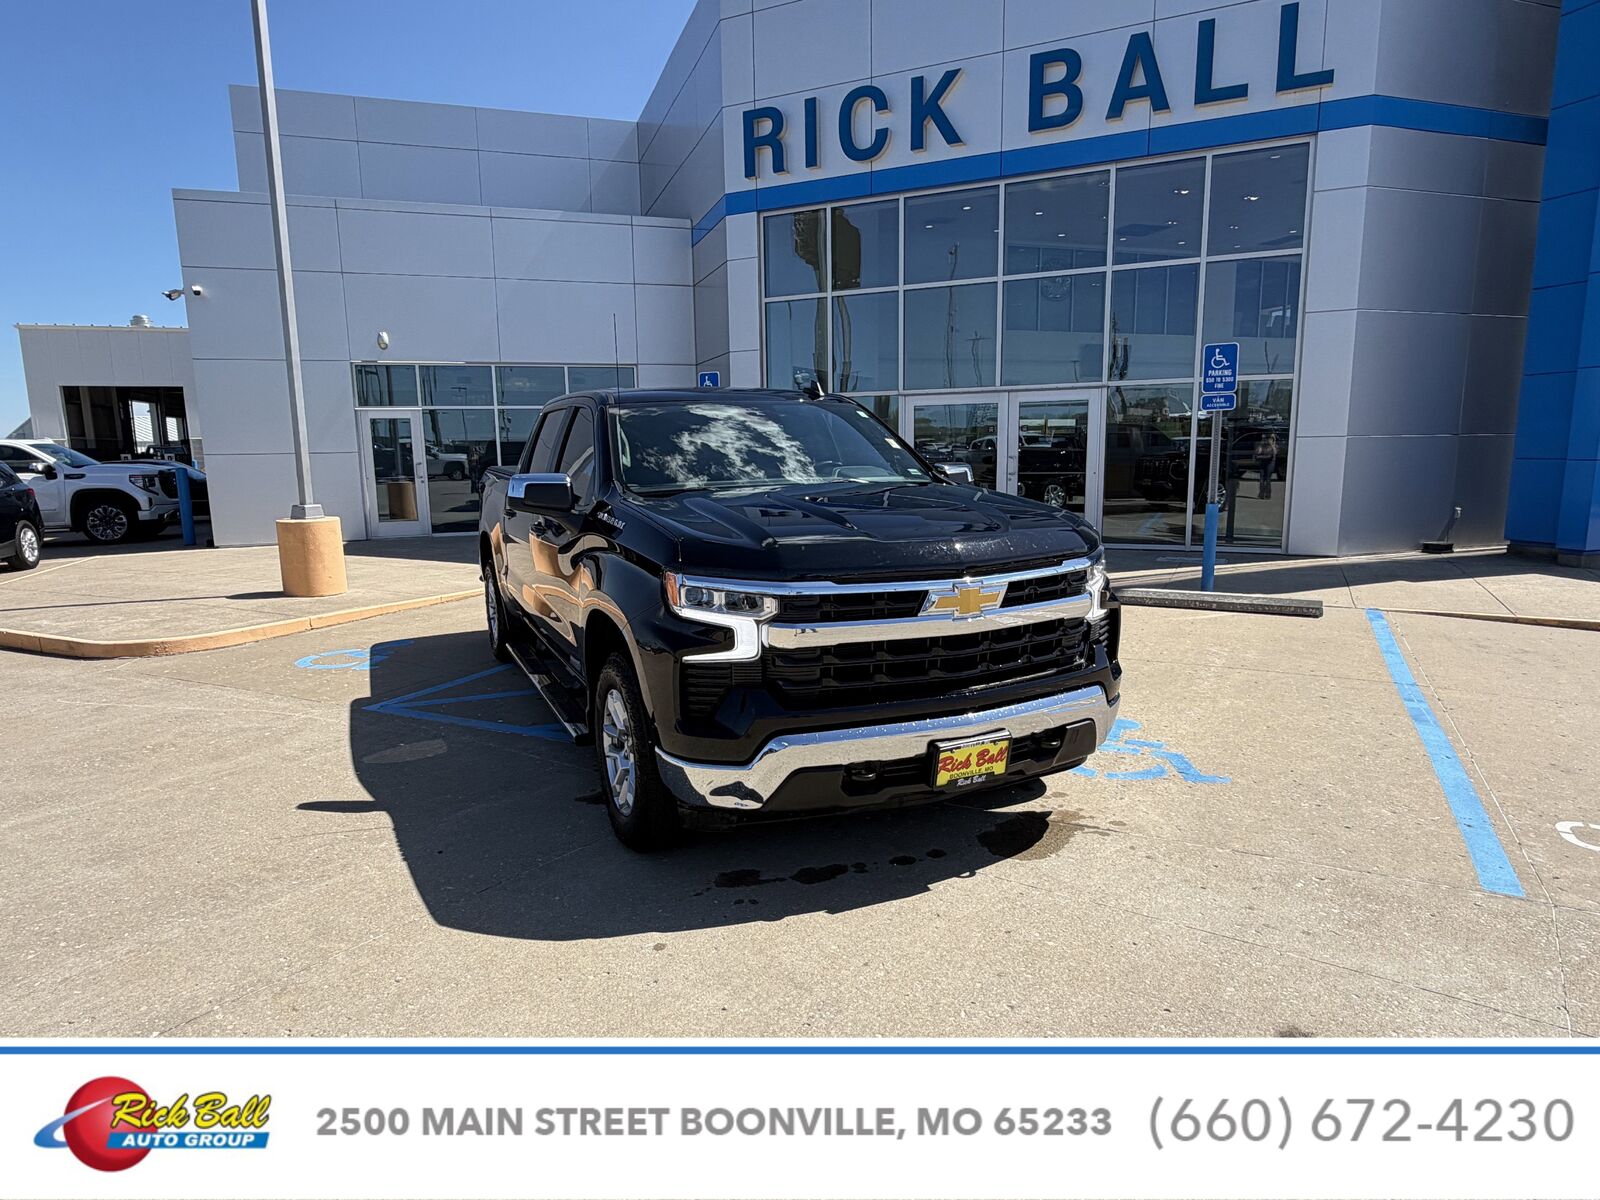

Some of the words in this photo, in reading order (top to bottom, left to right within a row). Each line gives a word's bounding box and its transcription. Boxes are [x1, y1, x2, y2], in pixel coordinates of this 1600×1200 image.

[742, 68, 965, 181] RICK
[1027, 1, 1336, 134] BALL
[938, 753, 973, 774] Rick
[976, 747, 1008, 767] Ball
